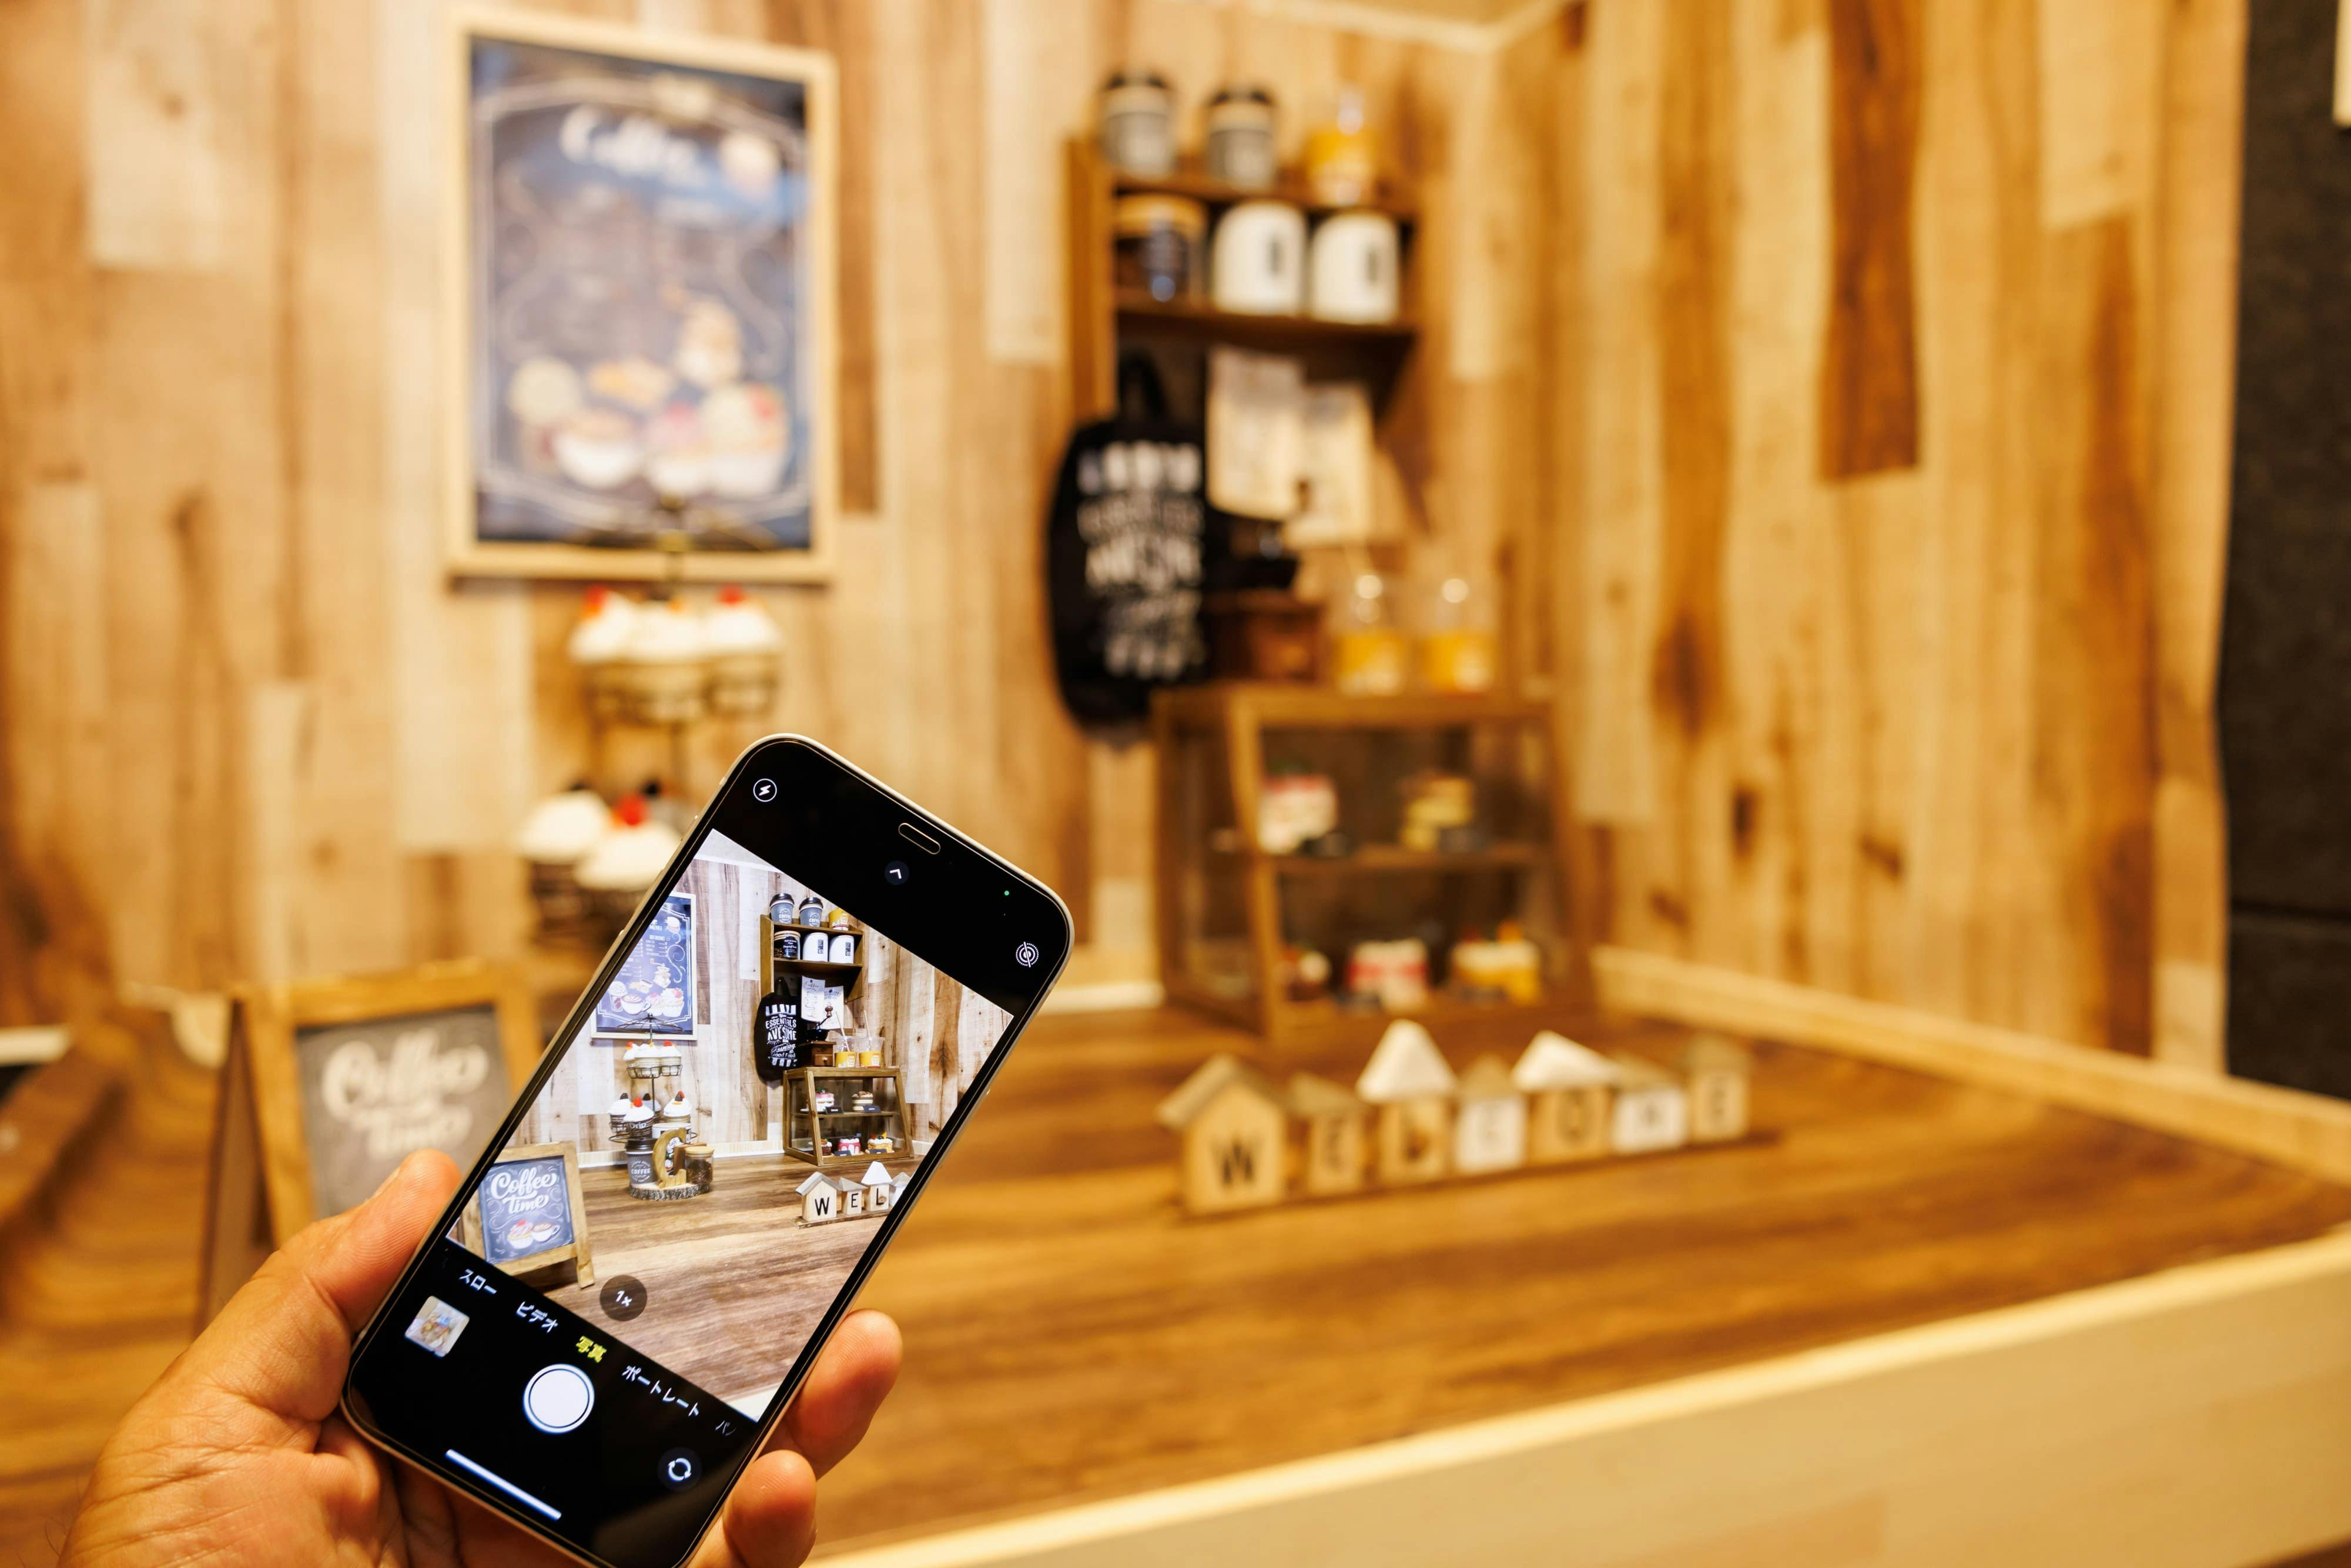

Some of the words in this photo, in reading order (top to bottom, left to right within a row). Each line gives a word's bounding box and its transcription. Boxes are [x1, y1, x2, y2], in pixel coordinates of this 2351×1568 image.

[490, 1167, 557, 1200] Coffee
[458, 1268, 497, 1295] スロー
[516, 1301, 558, 1333] ビデオ
[575, 1335, 607, 1363] 写真
[621, 1365, 699, 1417] ポートレート
